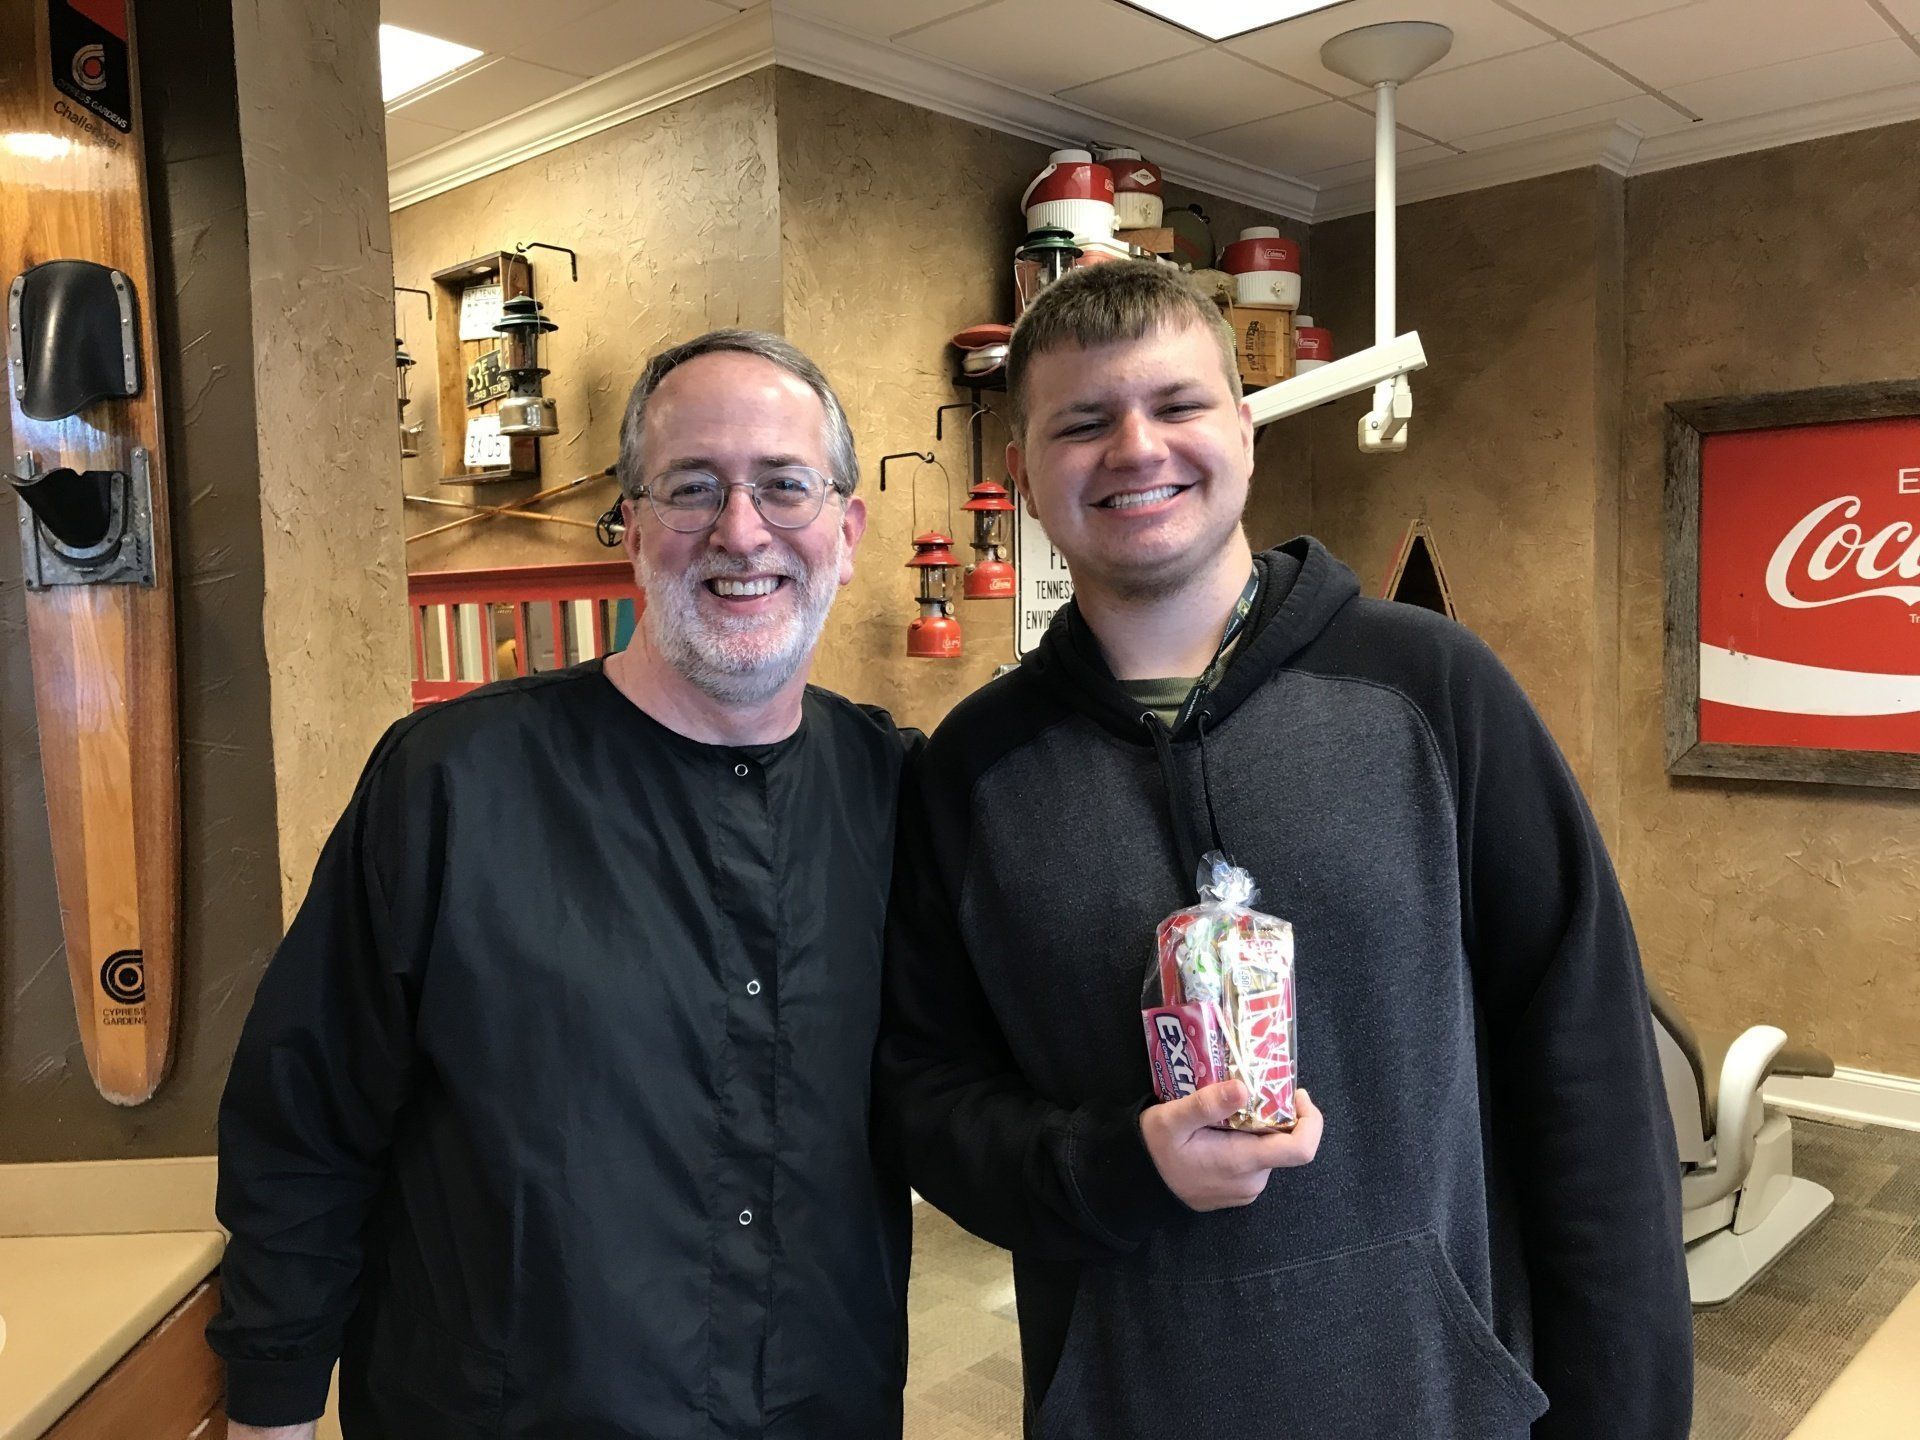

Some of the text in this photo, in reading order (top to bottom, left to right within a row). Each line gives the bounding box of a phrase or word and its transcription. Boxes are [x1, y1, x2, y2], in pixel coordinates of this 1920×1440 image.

[91, 101, 127, 128] GARDENS
[1245, 320, 1259, 351] RIVERS
[102, 1007, 147, 1017] CYPRESS
[103, 1017, 147, 1026] GARDENS
[1155, 1062, 1168, 1092] CLASSIC
